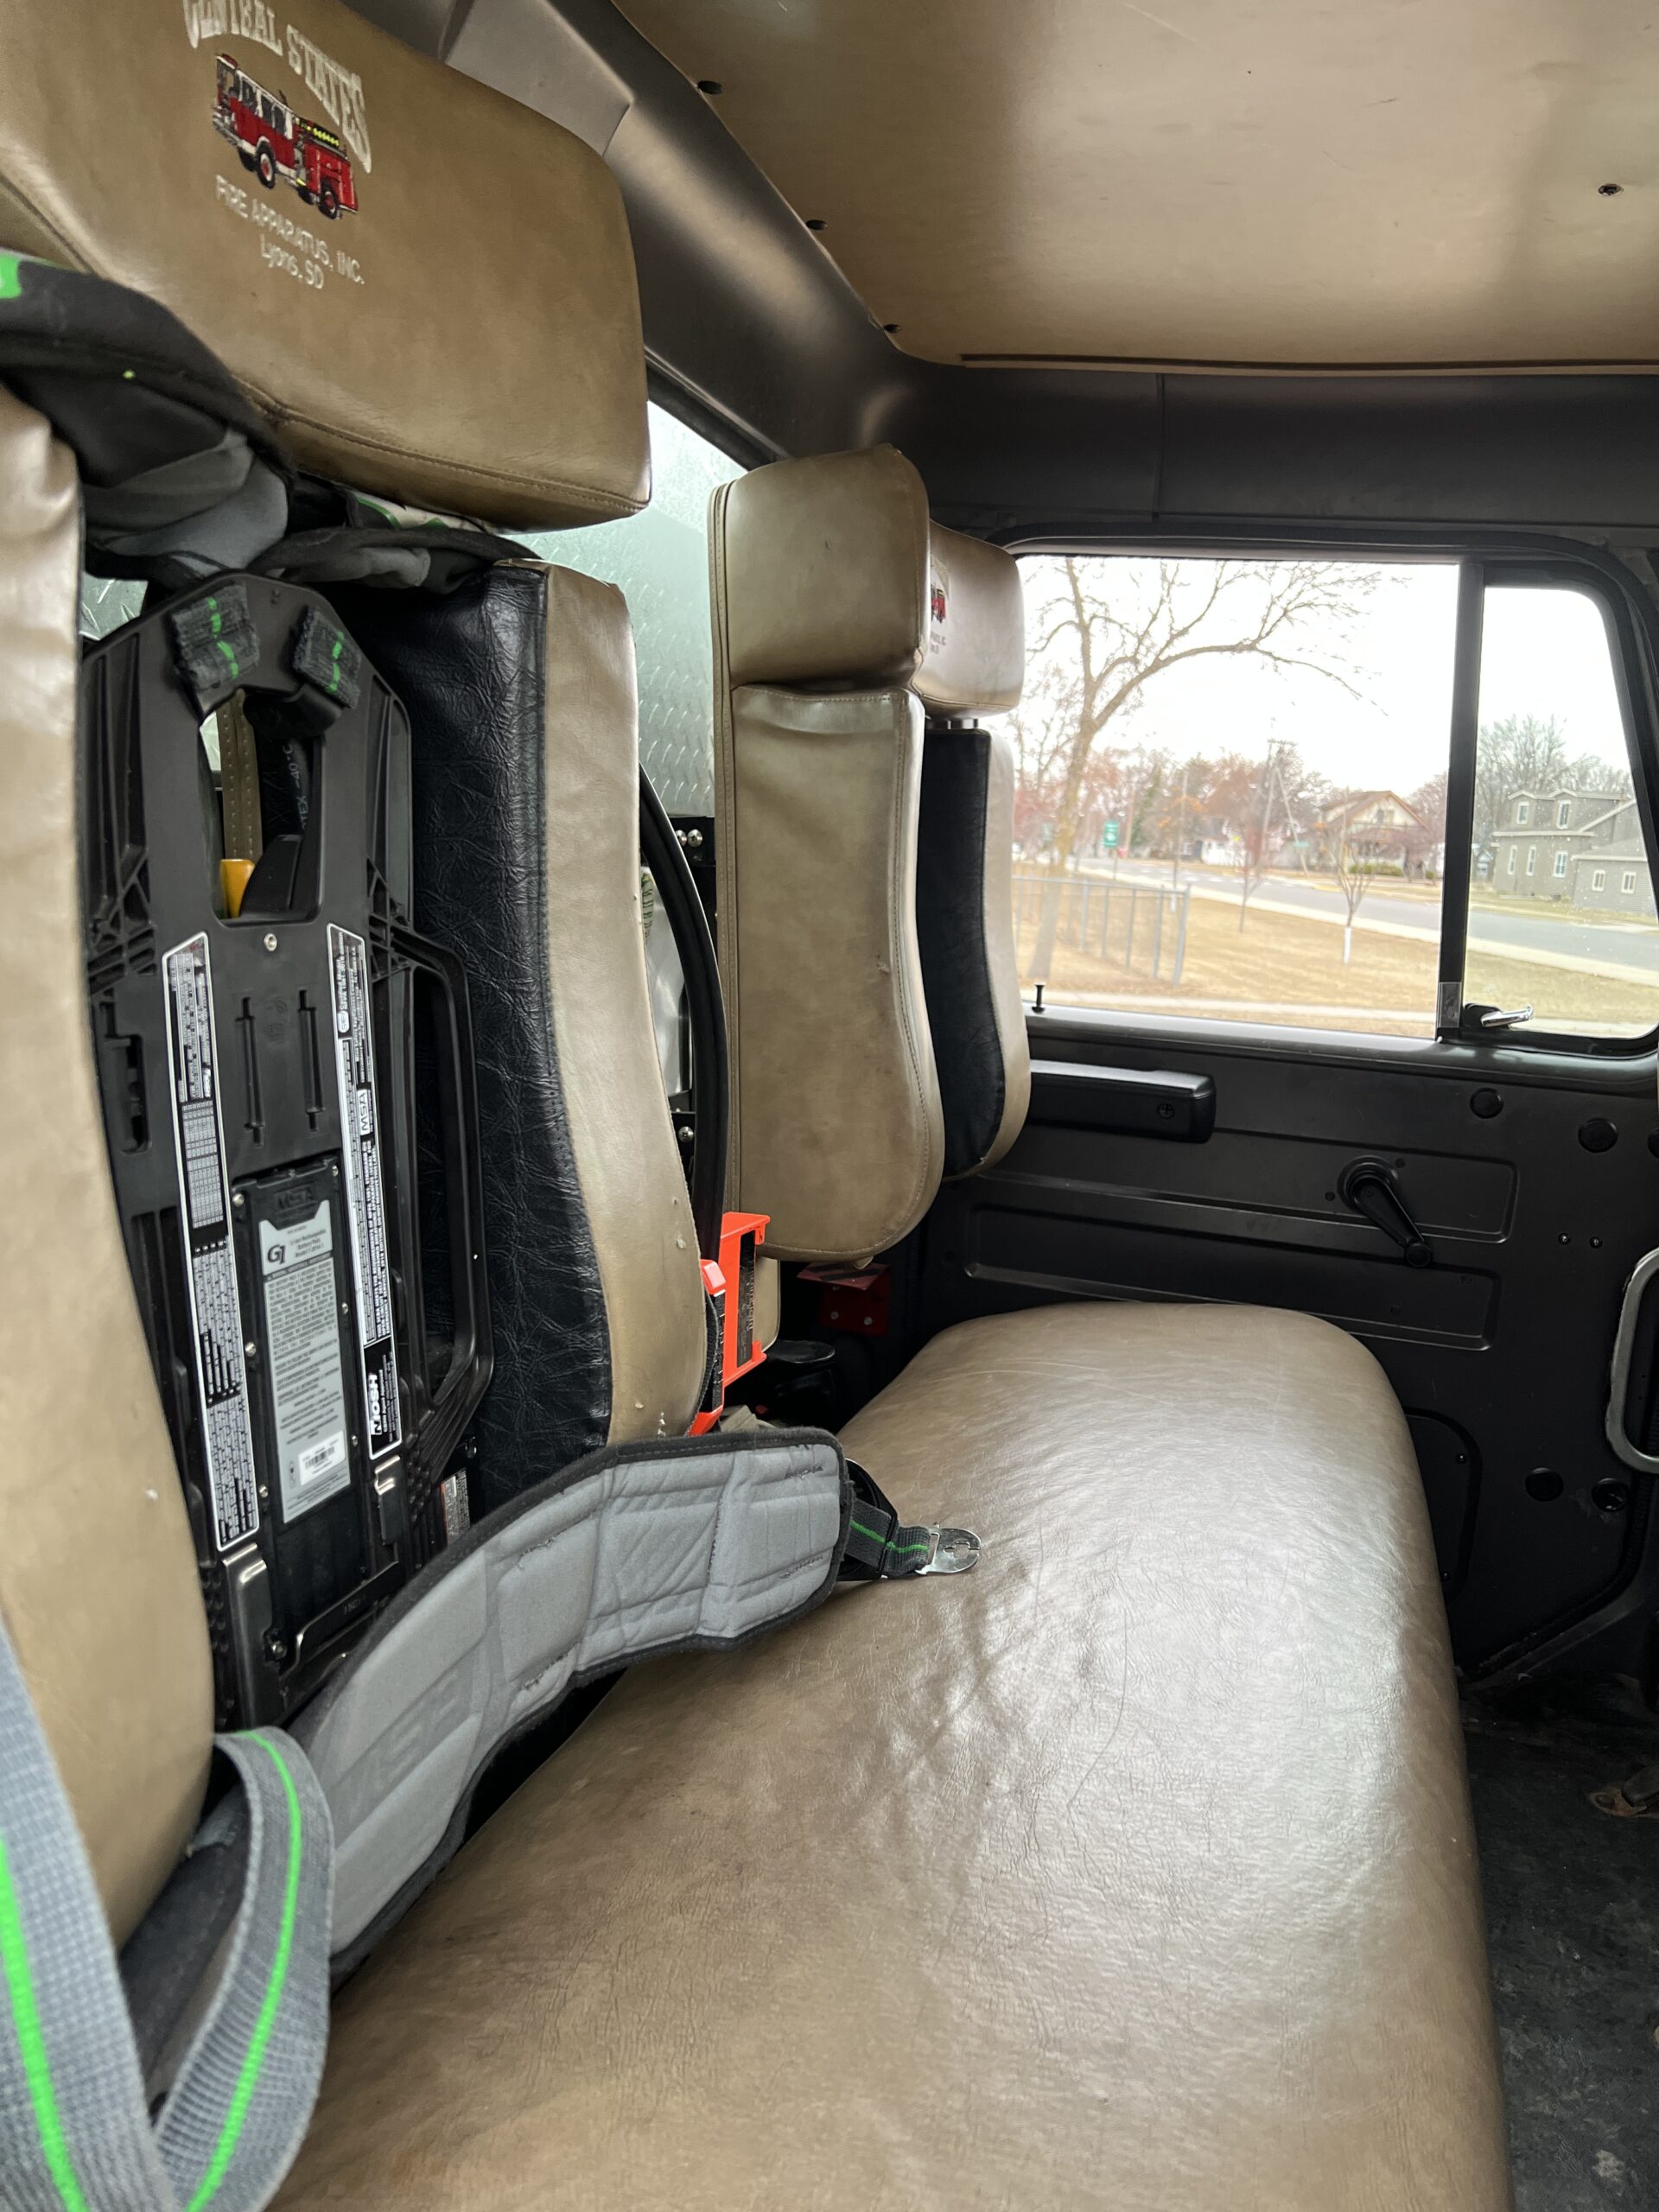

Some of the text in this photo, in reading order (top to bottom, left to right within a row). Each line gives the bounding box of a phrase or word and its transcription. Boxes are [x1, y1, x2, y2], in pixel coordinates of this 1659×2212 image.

[286, 23, 372, 173] STATES
[216, 175, 248, 218] FIRE
[337, 250, 365, 284] INC.
[305, 259, 324, 289] SD
[359, 1092, 368, 1131] MSA
[266, 1244, 286, 1265] G1
[368, 1374, 382, 1435] NIOSH
